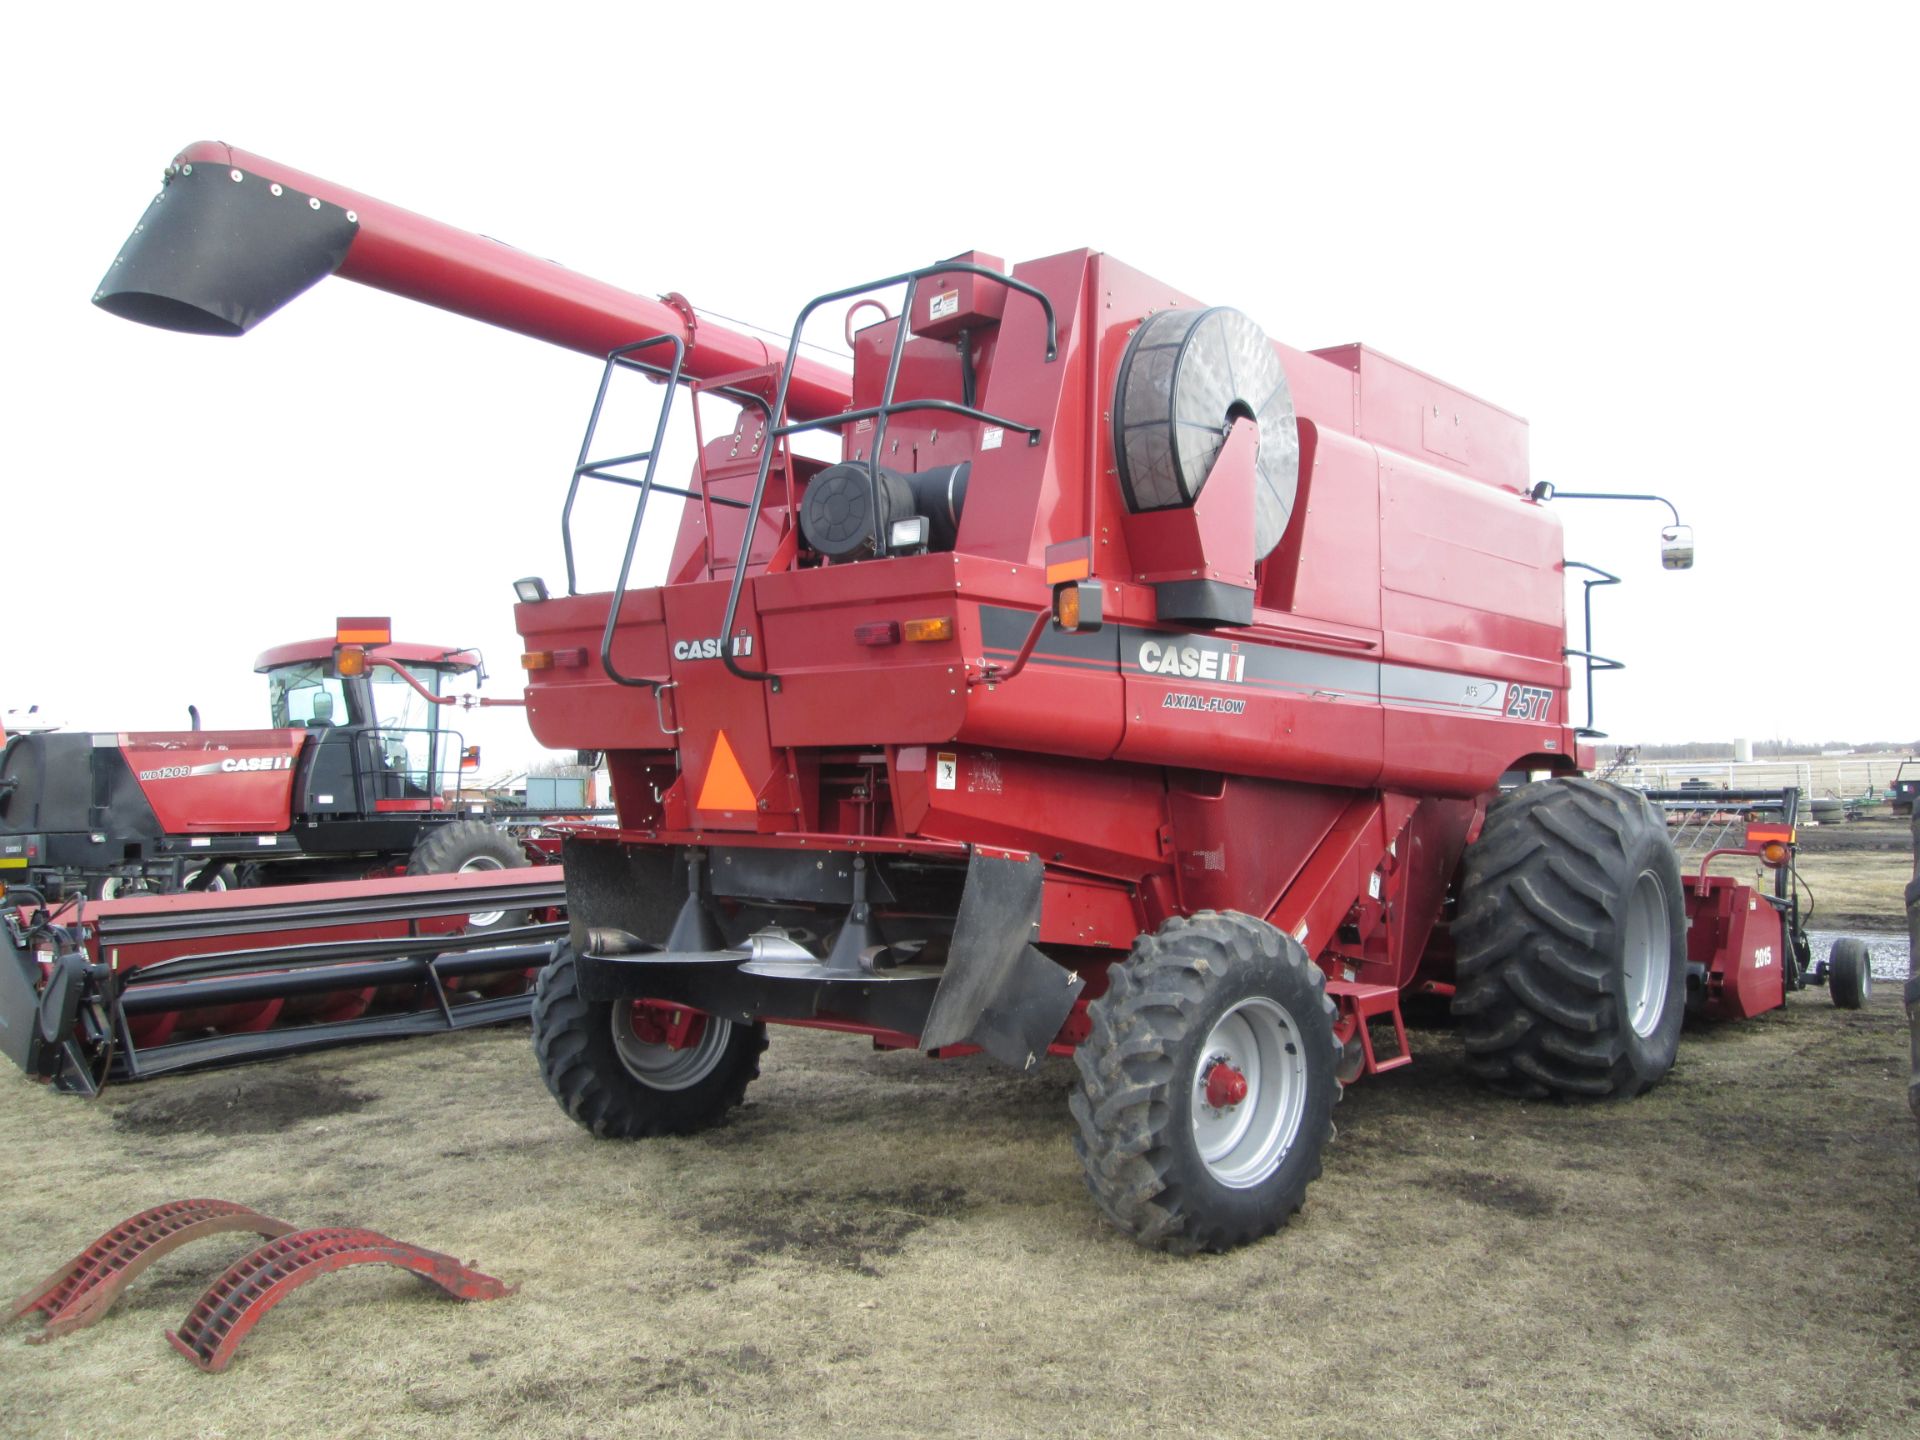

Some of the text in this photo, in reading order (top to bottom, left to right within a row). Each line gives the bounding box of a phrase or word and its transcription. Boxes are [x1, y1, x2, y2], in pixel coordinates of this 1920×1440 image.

[1139, 641, 1218, 680] CASE
[1162, 692, 1246, 714] AXIAL-FLOW
[1506, 684, 1553, 721] 2577
[140, 766, 190, 781] WD1203
[221, 757, 272, 772] CASE
[1754, 946, 1772, 968] 2015
